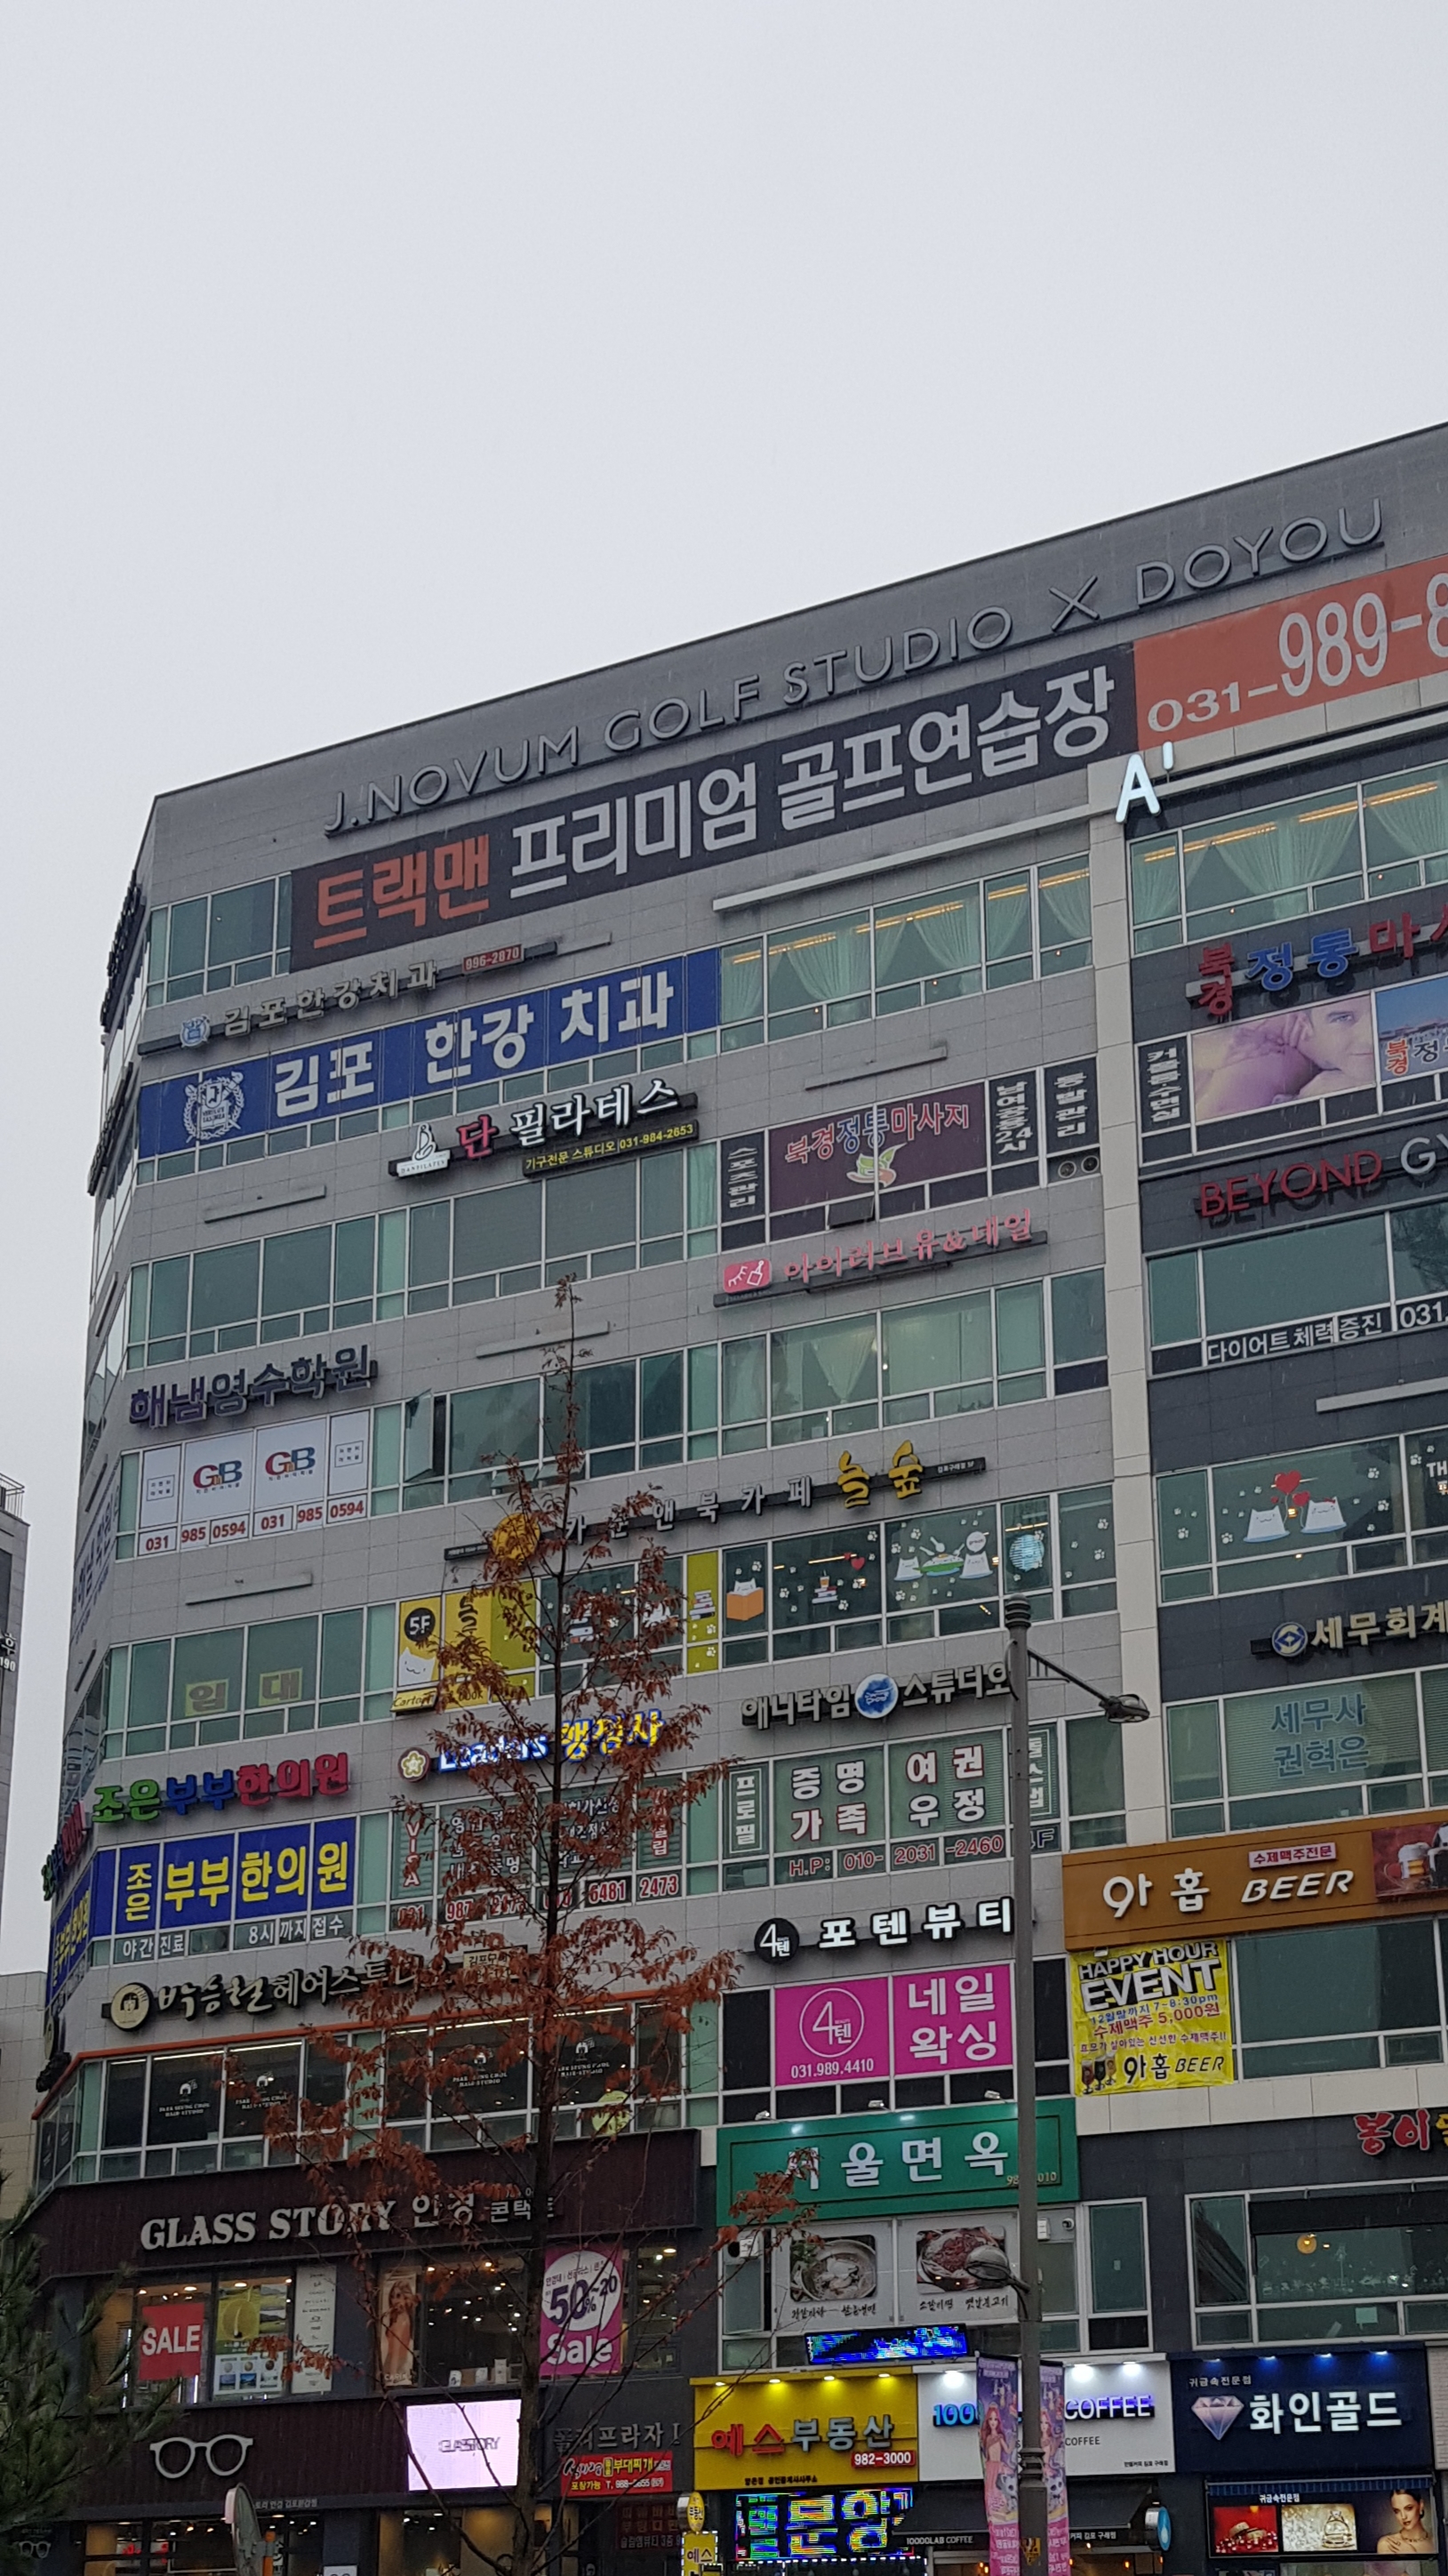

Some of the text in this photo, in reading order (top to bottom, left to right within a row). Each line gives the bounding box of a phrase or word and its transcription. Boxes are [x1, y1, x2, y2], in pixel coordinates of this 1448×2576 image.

[604, 675, 760, 753] GOLF
[783, 605, 1012, 706] STUDIO
[1048, 575, 1100, 632] X
[1135, 499, 1383, 607] DOYOU
[314, 665, 1115, 949] 트랙맨 프리미엄 골프연습장
[464, 947, 520, 972] 996-2870
[225, 960, 438, 1038] 김포한강치과
[275, 972, 674, 1118] 김포 한강 치과
[457, 1079, 678, 1160] 단 필라테스
[525, 1123, 694, 1171] 기구전문 스튜디오 031-984-2653
[1199, 1150, 1383, 1218] BEYOND
[1207, 1329, 1292, 1364] 다이어트
[129, 1344, 379, 1430] 해냄영수학원
[146, 1500, 364, 1553] 031 985 0594 031 985 0594
[740, 1661, 1012, 1730] 애니타임 스튜디오
[1271, 1693, 1367, 1735] 세무사
[92, 1752, 349, 1824] 조은부부한의원
[792, 1745, 984, 1802] 증명 여권
[735, 1776, 756, 1846] 프로필
[791, 1787, 987, 1842] 가족 우정
[894, 1844, 936, 1865] 2031
[1252, 1844, 1333, 1866] 수제맥주전문
[126, 1842, 349, 1922] 조은 부부한의원
[588, 1880, 628, 1905] 6481
[639, 1874, 679, 1898] 2473
[1241, 1870, 1356, 1904] BEER
[445, 1899, 474, 1922] 987
[818, 1897, 1012, 1950] 포텐뷰티
[123, 1937, 155, 1960] 야간
[160, 1934, 184, 1956] 진료
[312, 1915, 344, 1937] 접수
[1078, 1941, 1218, 1981] HAPPY HOUR
[908, 1972, 996, 2016] 네일
[1080, 1958, 1220, 2013] EVENT
[1094, 2002, 1220, 2039] 수제맥주 5,000원
[908, 2020, 998, 2066] 왁싱
[1175, 2056, 1225, 2074] BEER
[790, 2058, 874, 2080] 031.989.4410
[1354, 2108, 1431, 2155] 봉이
[140, 2211, 257, 2251] GLASS
[268, 2201, 396, 2241] STORY
[412, 2194, 475, 2228] 안경
[142, 2324, 201, 2356] SALE
[547, 2333, 612, 2369] Sale
[1189, 2375, 1252, 2387] 귀금속전문점
[1063, 2395, 1152, 2420] COFFEE
[1250, 2391, 1403, 2435] 화인골드
[854, 2451, 912, 2467] 982-3000
[1064, 2436, 1100, 2447] COFFEE
[946, 2535, 973, 2544] COFFEE
